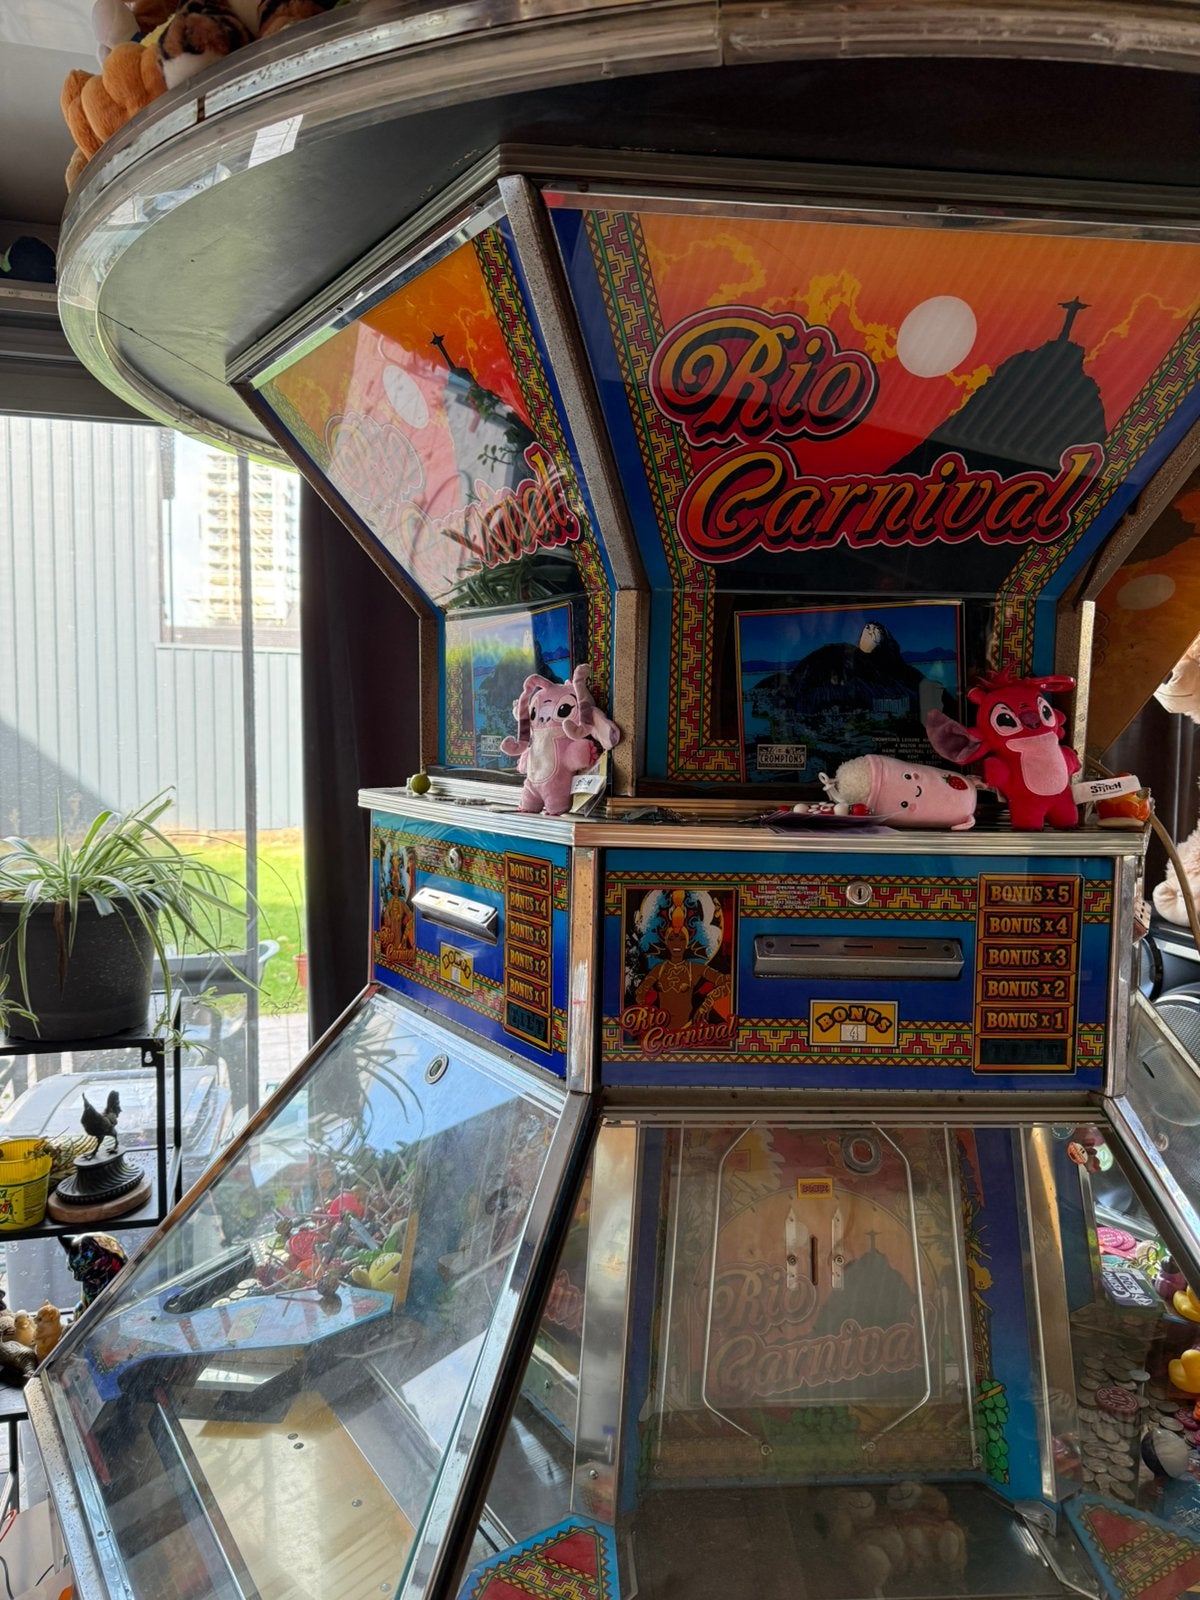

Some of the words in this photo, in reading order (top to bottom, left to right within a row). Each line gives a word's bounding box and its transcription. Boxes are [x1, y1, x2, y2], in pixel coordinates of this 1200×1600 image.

[654, 311, 872, 441] Rio
[680, 446, 1101, 557] Carnival
[760, 754, 803, 763] CROMPTONS
[1091, 782, 1122, 793] STITCH
[509, 862, 534, 885] BONUS
[540, 868, 547, 886] 5
[509, 891, 534, 913] BONUS
[540, 900, 547, 917] 4
[990, 885, 1043, 902] BONUS
[1046, 888, 1055, 900] x
[1058, 885, 1070, 903] 5
[509, 920, 534, 942] BONUS
[540, 929, 547, 946] 3
[989, 917, 1041, 934] BONUS
[1044, 920, 1053, 932] x
[1056, 917, 1068, 934] 4
[442, 950, 472, 980] BONUS
[509, 949, 534, 971] BONUS
[540, 959, 547, 976] 2
[988, 949, 1040, 965] BONUS
[1043, 952, 1052, 963] x
[1055, 948, 1067, 966] 3
[509, 977, 534, 1001] BONUS
[540, 990, 547, 1008] 1
[987, 980, 1039, 997] BONUS
[1042, 983, 1051, 995] x
[1054, 980, 1065, 998] 2
[621, 1006, 671, 1033] Rio
[816, 1004, 892, 1033] BONUS
[986, 1012, 1038, 1029] BONUS
[1041, 1015, 1050, 1027] x
[1055, 1012, 1064, 1029] 1
[641, 1015, 737, 1054] Carnival
[849, 1025, 859, 1041] 4
[702, 1264, 815, 1329] Rio
[708, 1309, 934, 1395] Carnival
